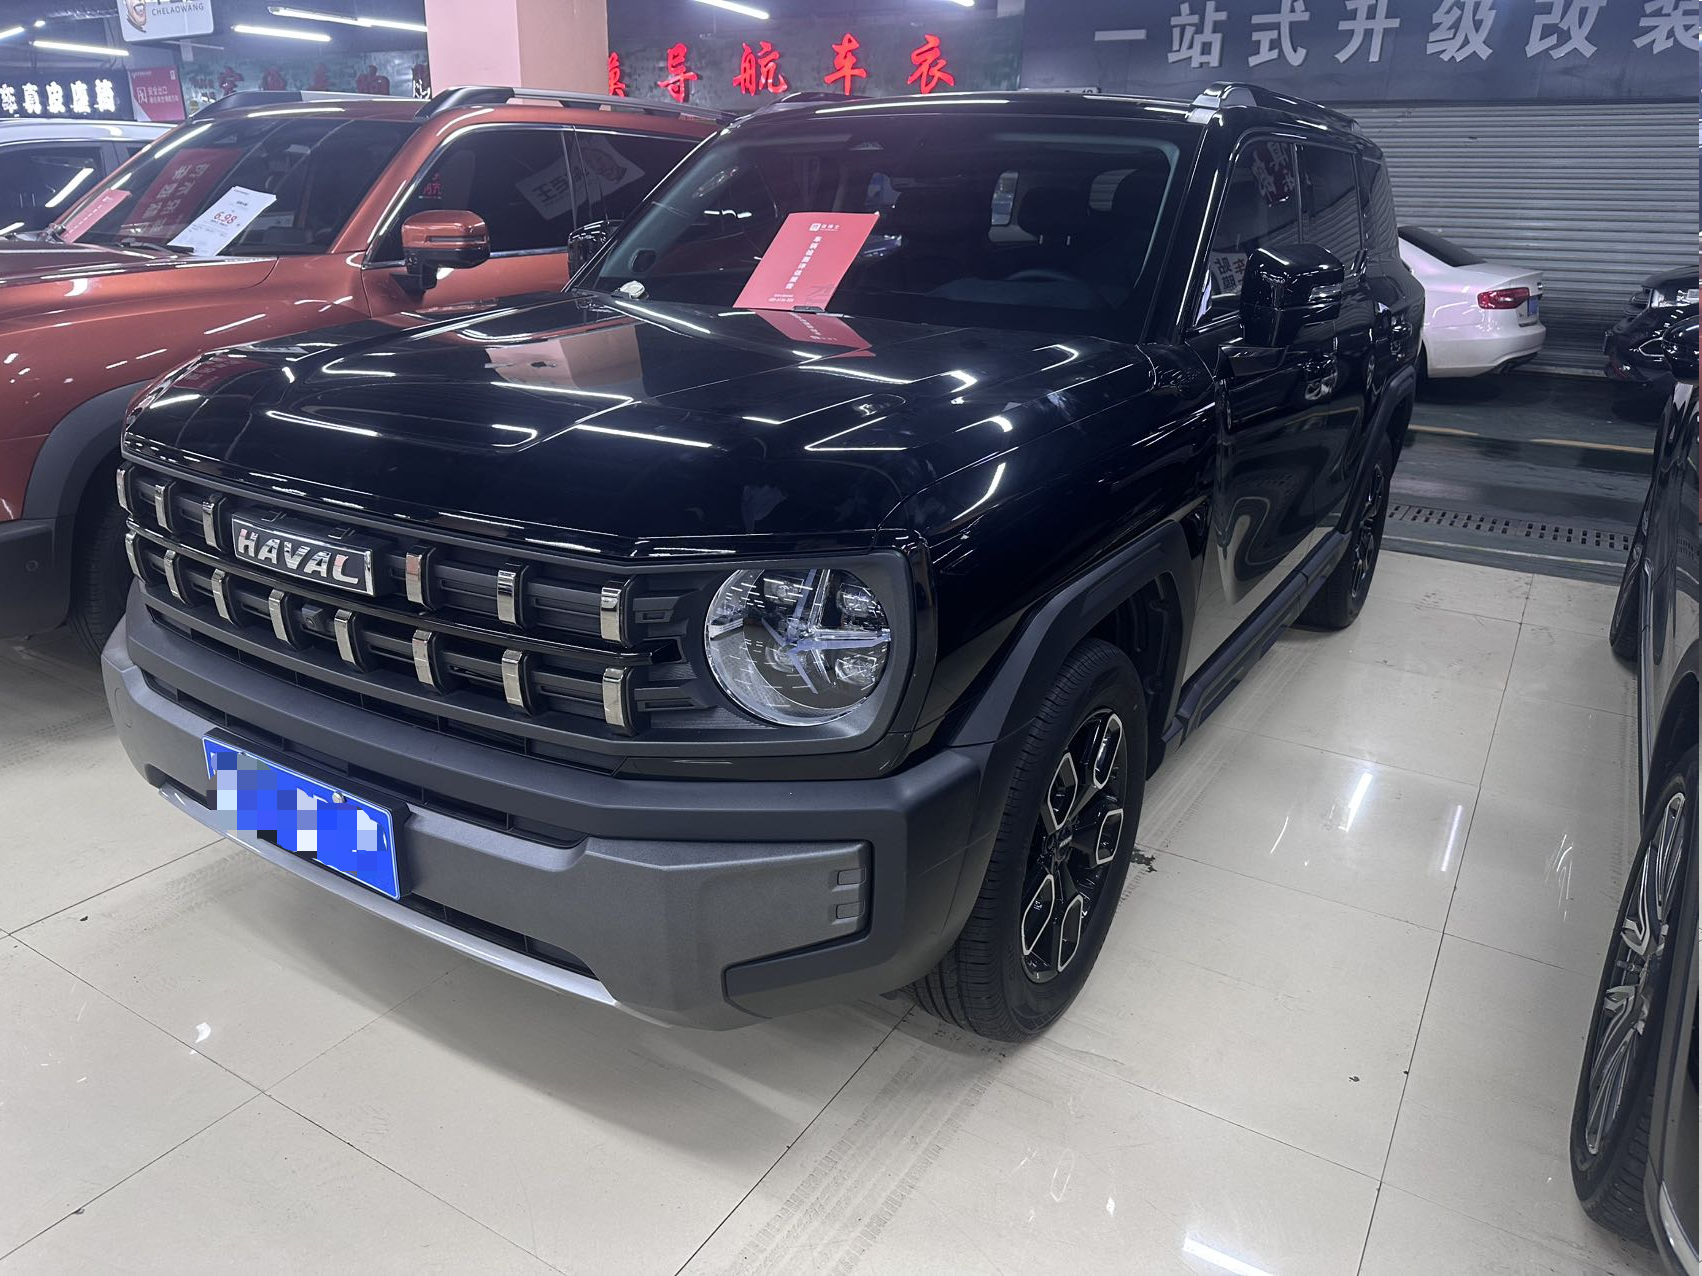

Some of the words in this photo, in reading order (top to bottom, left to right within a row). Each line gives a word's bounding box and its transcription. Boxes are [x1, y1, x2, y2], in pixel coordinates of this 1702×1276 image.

[151, 3, 204, 16] CHELAOWANG
[213, 211, 238, 225] 6.98
[237, 528, 359, 585] HAVAL
